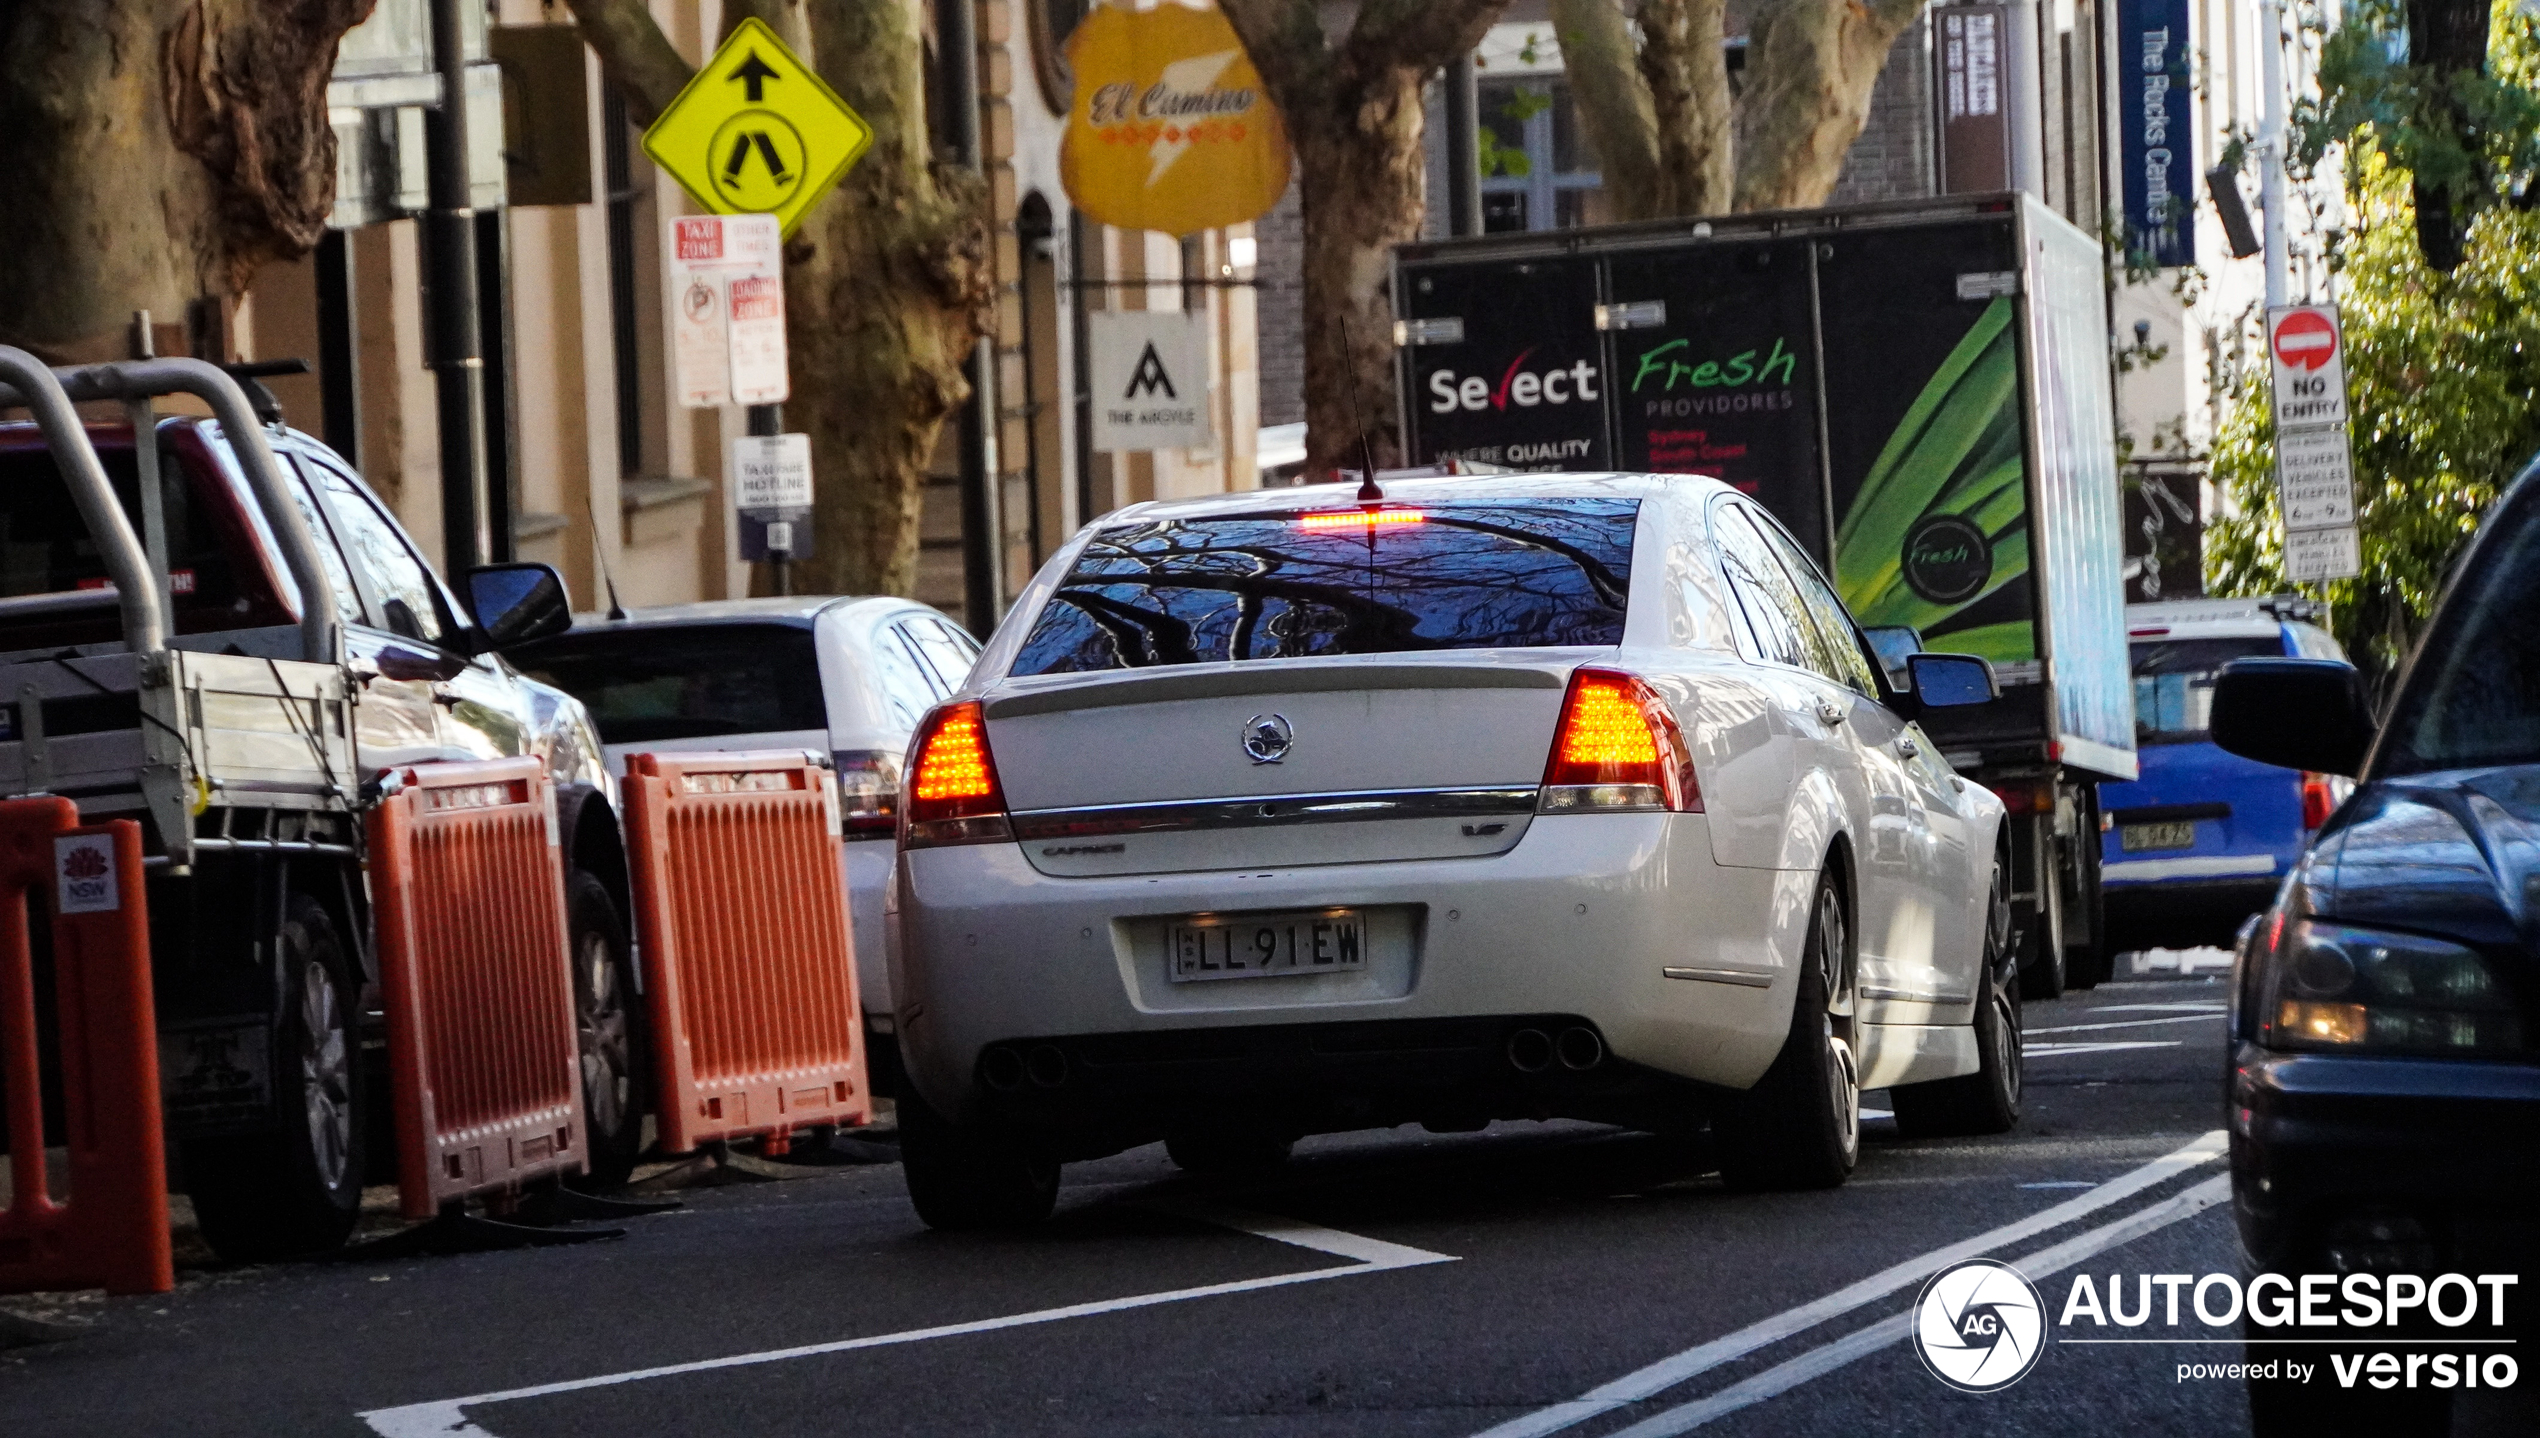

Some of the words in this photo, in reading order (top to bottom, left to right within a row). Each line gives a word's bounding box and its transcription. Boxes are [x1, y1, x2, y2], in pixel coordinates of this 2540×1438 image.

[2142, 25, 2169, 72] The
[1090, 81, 1133, 124] El
[1136, 81, 1256, 118] Camino
[2143, 74, 2171, 146] Rocks
[682, 219, 717, 238] TAXI
[680, 239, 721, 258] ZONE
[736, 299, 774, 319] ZONE
[1630, 336, 1796, 393] Fresh
[2293, 375, 2327, 397] NO
[1646, 390, 1793, 418] PROVIDORES
[2282, 398, 2340, 420] ENTRY
[1107, 408, 1132, 425] THE
[1140, 407, 1195, 426] ARGYLE
[1507, 438, 1591, 463] QUALITY
[2285, 451, 2343, 468] DELIVERY
[2289, 467, 2346, 485] VEHICLES
[1909, 543, 1969, 565] Fresh
[1042, 843, 1126, 857] CAPRICE
[68, 881, 106, 898] NSW
